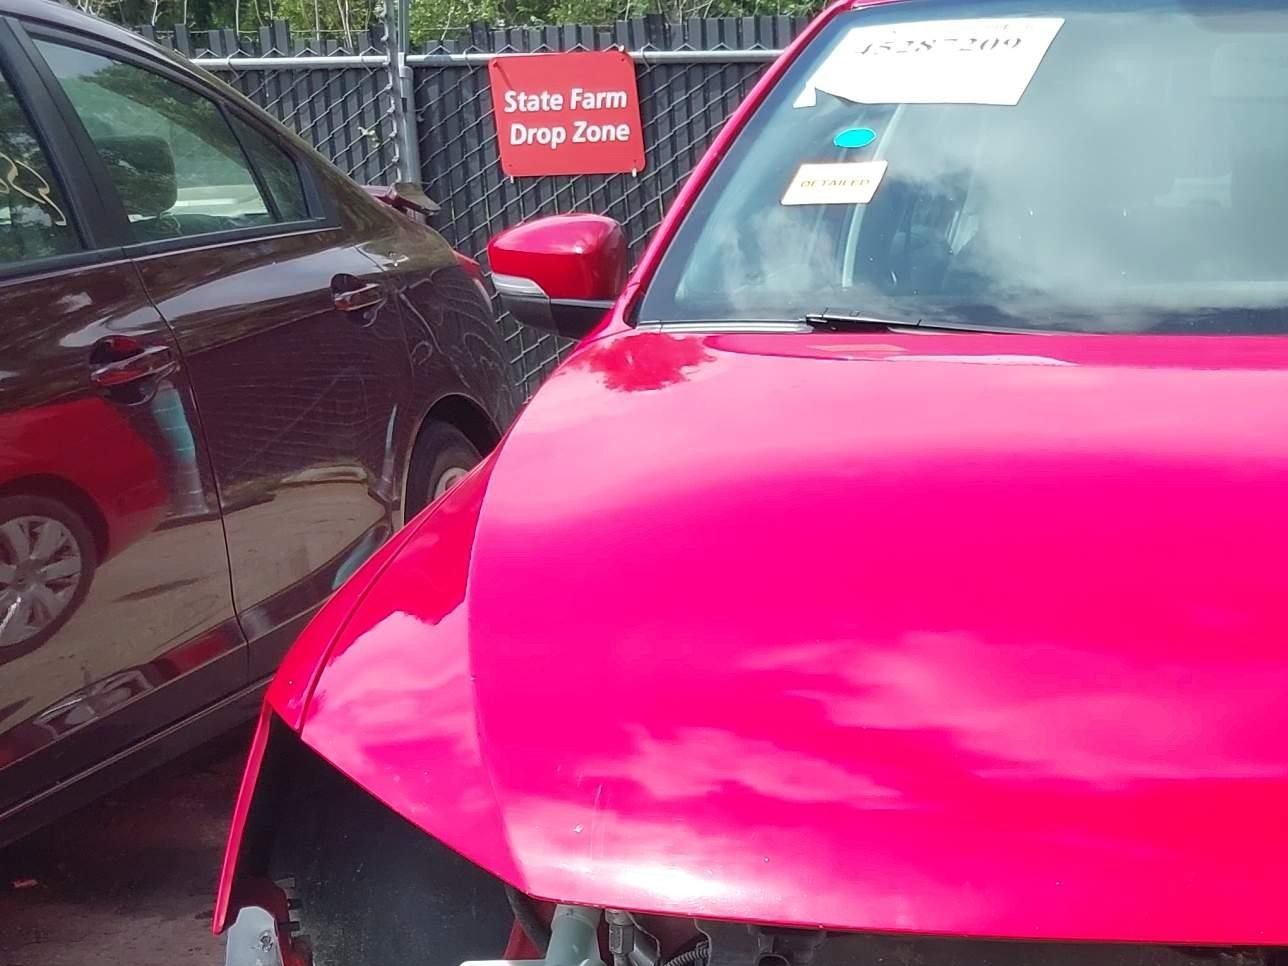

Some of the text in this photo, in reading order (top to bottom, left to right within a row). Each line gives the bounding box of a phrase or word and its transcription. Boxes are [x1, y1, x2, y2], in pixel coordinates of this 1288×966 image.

[504, 88, 627, 112] State Farm
[510, 121, 630, 149] Drop Zone
